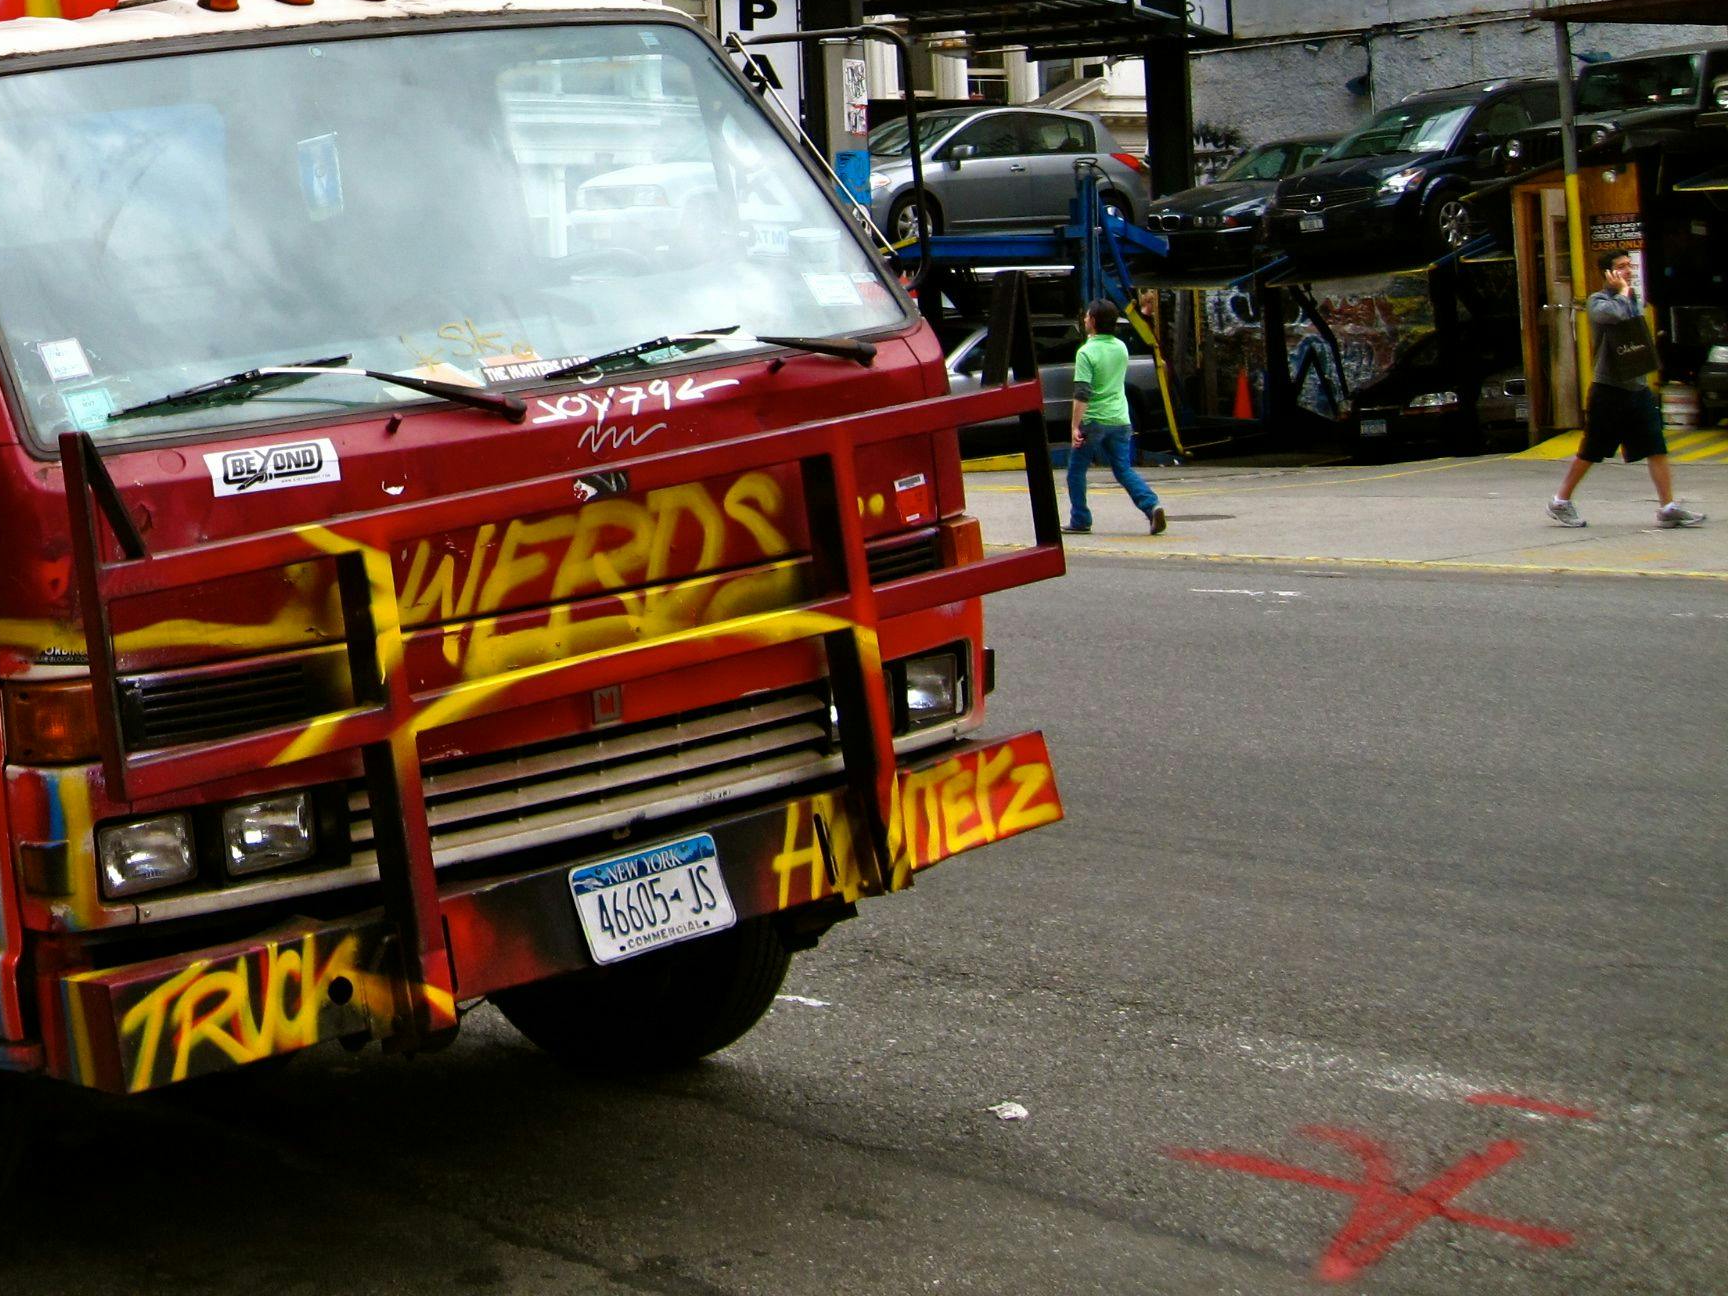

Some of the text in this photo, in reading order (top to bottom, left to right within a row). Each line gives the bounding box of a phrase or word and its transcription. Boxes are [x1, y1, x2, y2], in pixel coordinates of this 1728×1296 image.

[229, 446, 317, 481] BEYOND
[607, 850, 682, 884] NEW YORK
[627, 919, 703, 950] COMMERCIAL
